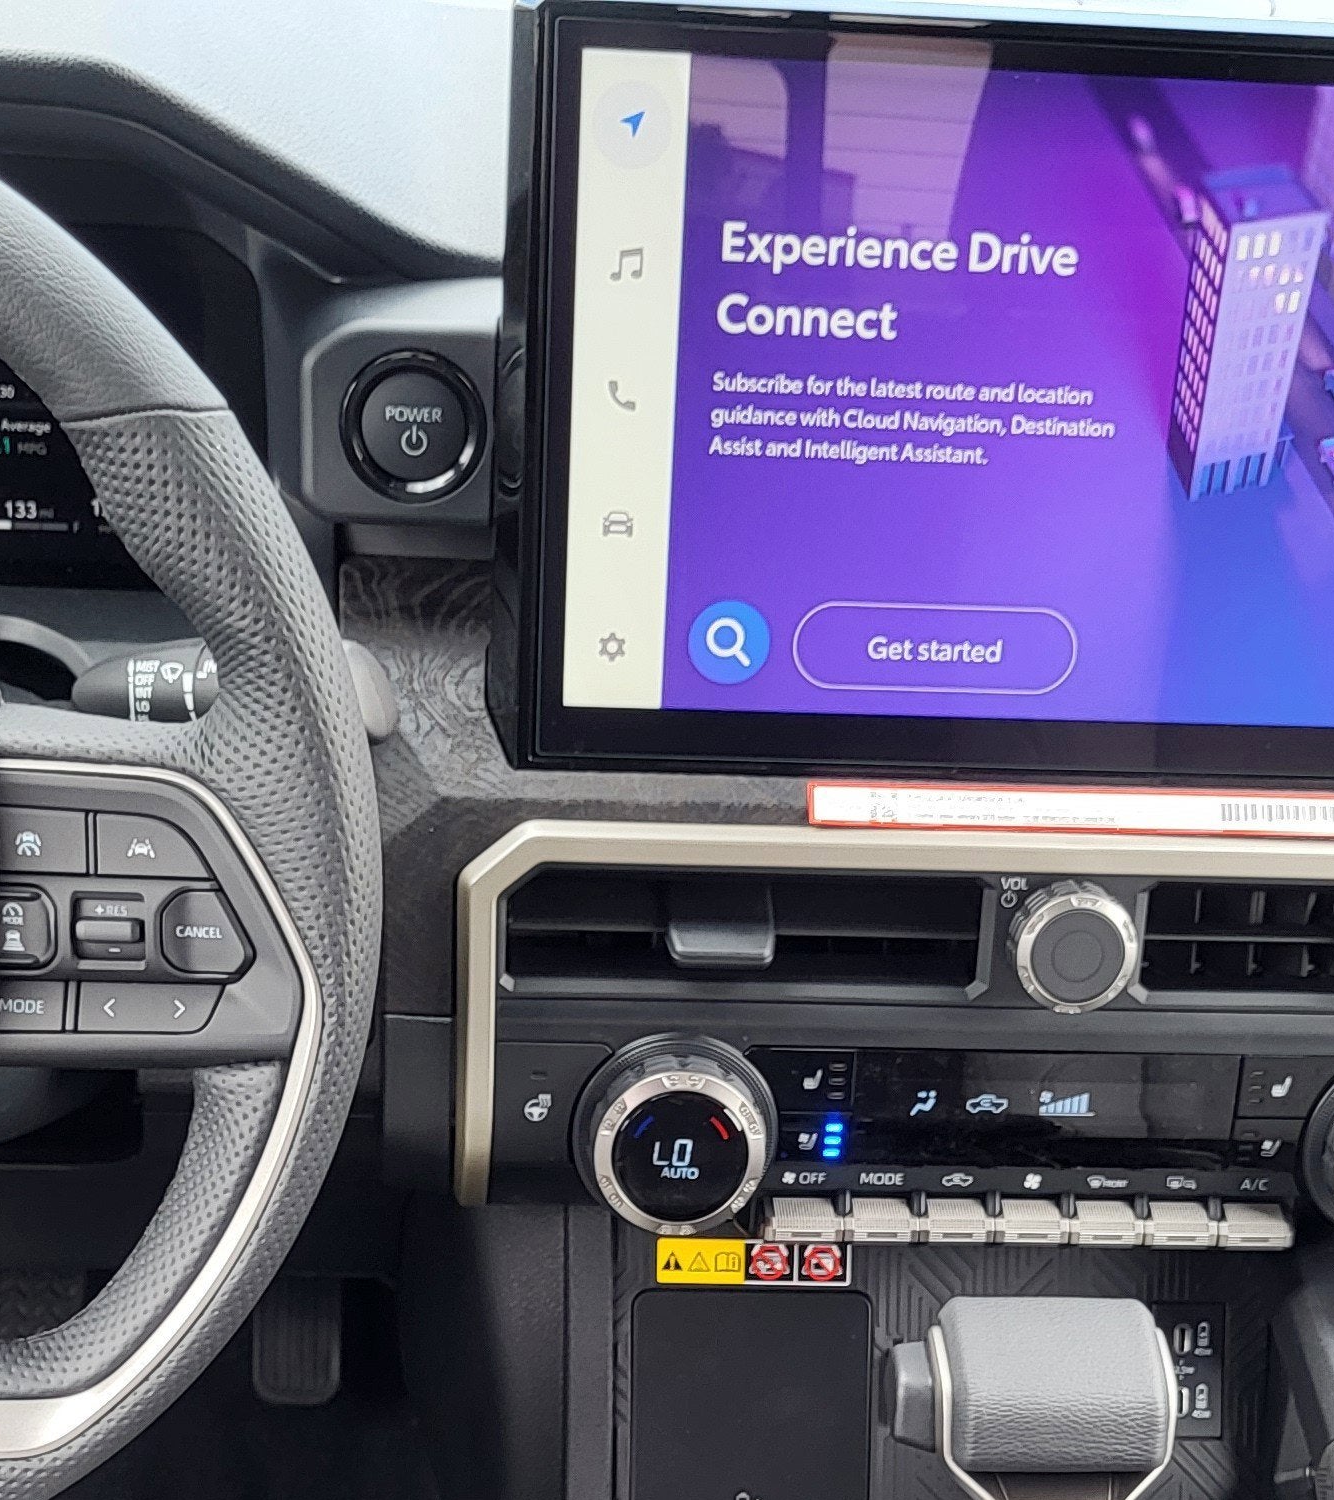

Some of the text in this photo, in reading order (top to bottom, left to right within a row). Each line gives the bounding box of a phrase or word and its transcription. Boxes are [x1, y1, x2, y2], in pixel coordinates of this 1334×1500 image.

[720, 221, 1080, 276] Experience Drive
[716, 292, 898, 341] Connect
[0, 384, 14, 399] 30
[712, 371, 1093, 406] Subscribe for the latest route and location
[384, 405, 442, 423] POWER
[711, 405, 1115, 439] guidance with Cloud Navigation, Destination
[0, 418, 51, 435] Average
[708, 435, 988, 465] Assist and Intelligent Assistant.
[4, 501, 37, 519] 133
[867, 636, 1003, 664] Get started
[134, 673, 156, 686] OFF
[135, 699, 150, 713] LO
[1000, 876, 1028, 891] VOL
[175, 925, 223, 940] CANCEL
[660, 1166, 699, 1180] AUTO
[798, 1171, 827, 1185] OFF
[859, 1171, 905, 1186] MODE
[1240, 1178, 1269, 1191] A/C
